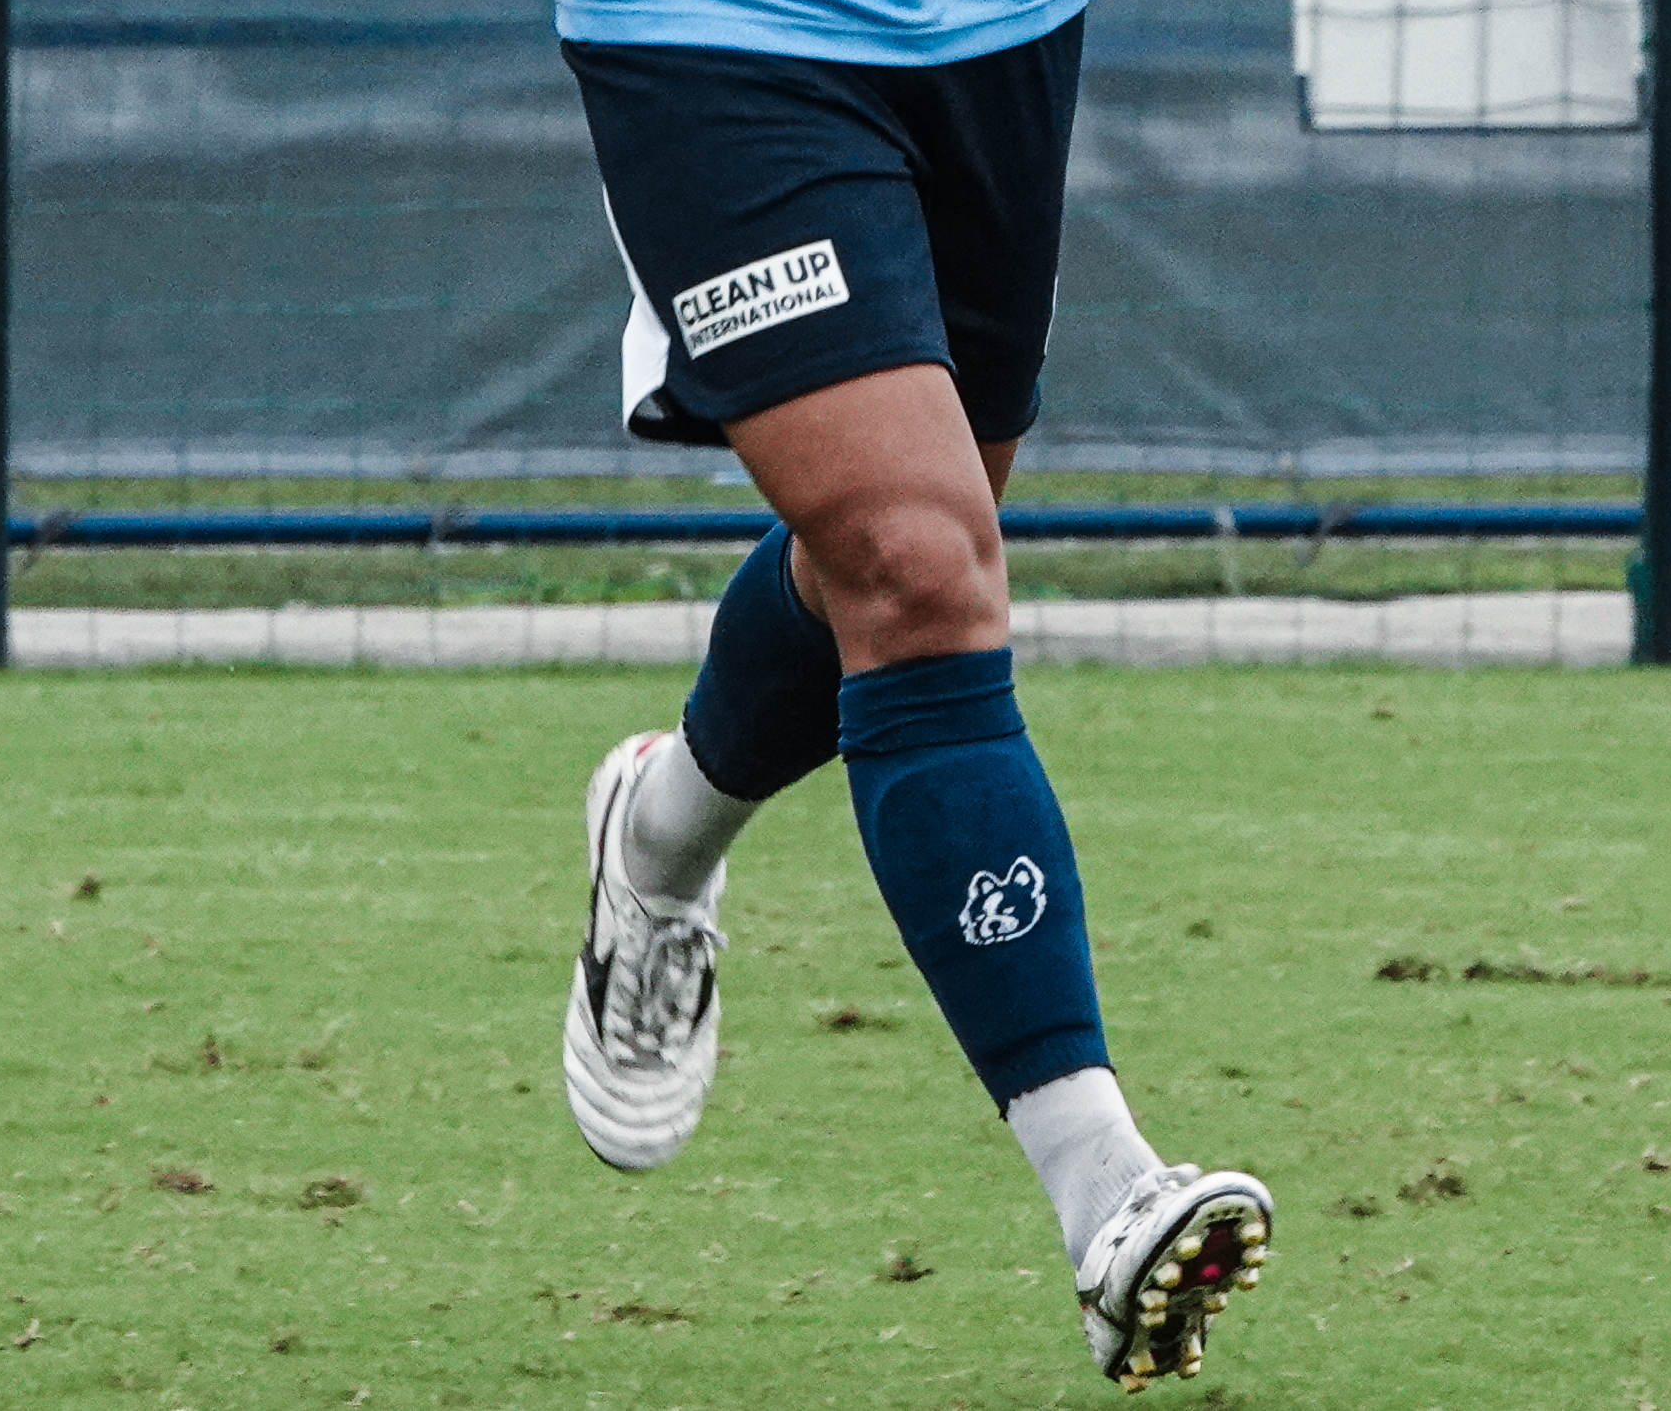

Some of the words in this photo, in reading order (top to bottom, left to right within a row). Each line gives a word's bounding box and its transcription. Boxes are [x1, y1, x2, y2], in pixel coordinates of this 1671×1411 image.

[680, 266, 776, 328] CLEAN
[782, 250, 831, 284] UP
[689, 281, 842, 349] INTERNATIONAL
